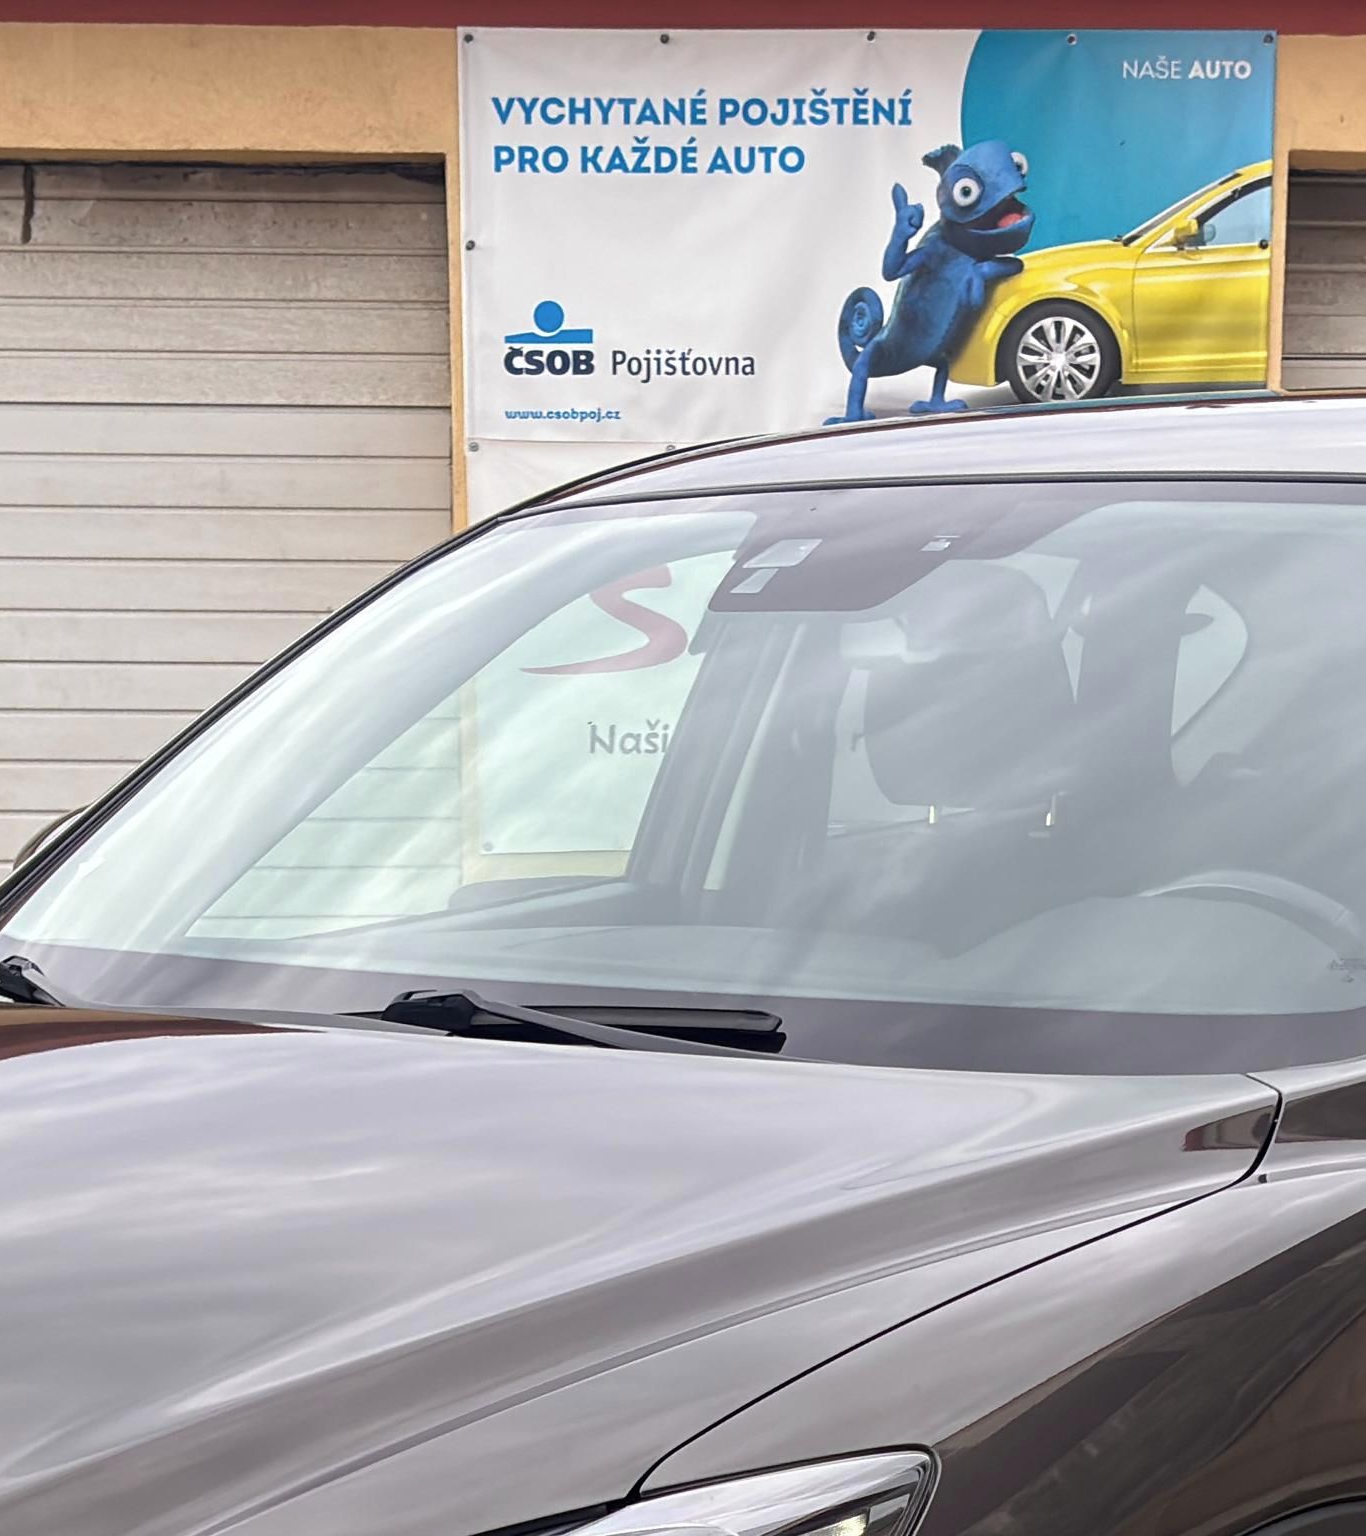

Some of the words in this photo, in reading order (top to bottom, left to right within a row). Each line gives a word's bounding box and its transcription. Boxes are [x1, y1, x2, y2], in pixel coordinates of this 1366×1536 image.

[1122, 55, 1182, 80] NAŠE
[1188, 59, 1252, 80] AUTO
[491, 88, 708, 126] VYCHYTANÉ
[718, 88, 913, 126] POJIŠTĚNÍ
[493, 145, 569, 175] PRO
[580, 136, 697, 175] KAŽDÉ
[706, 145, 806, 175] AUTO
[504, 346, 595, 375] ČSOB
[611, 348, 756, 383] Pojišťovna
[505, 407, 622, 423] www.csobpoj.cz
